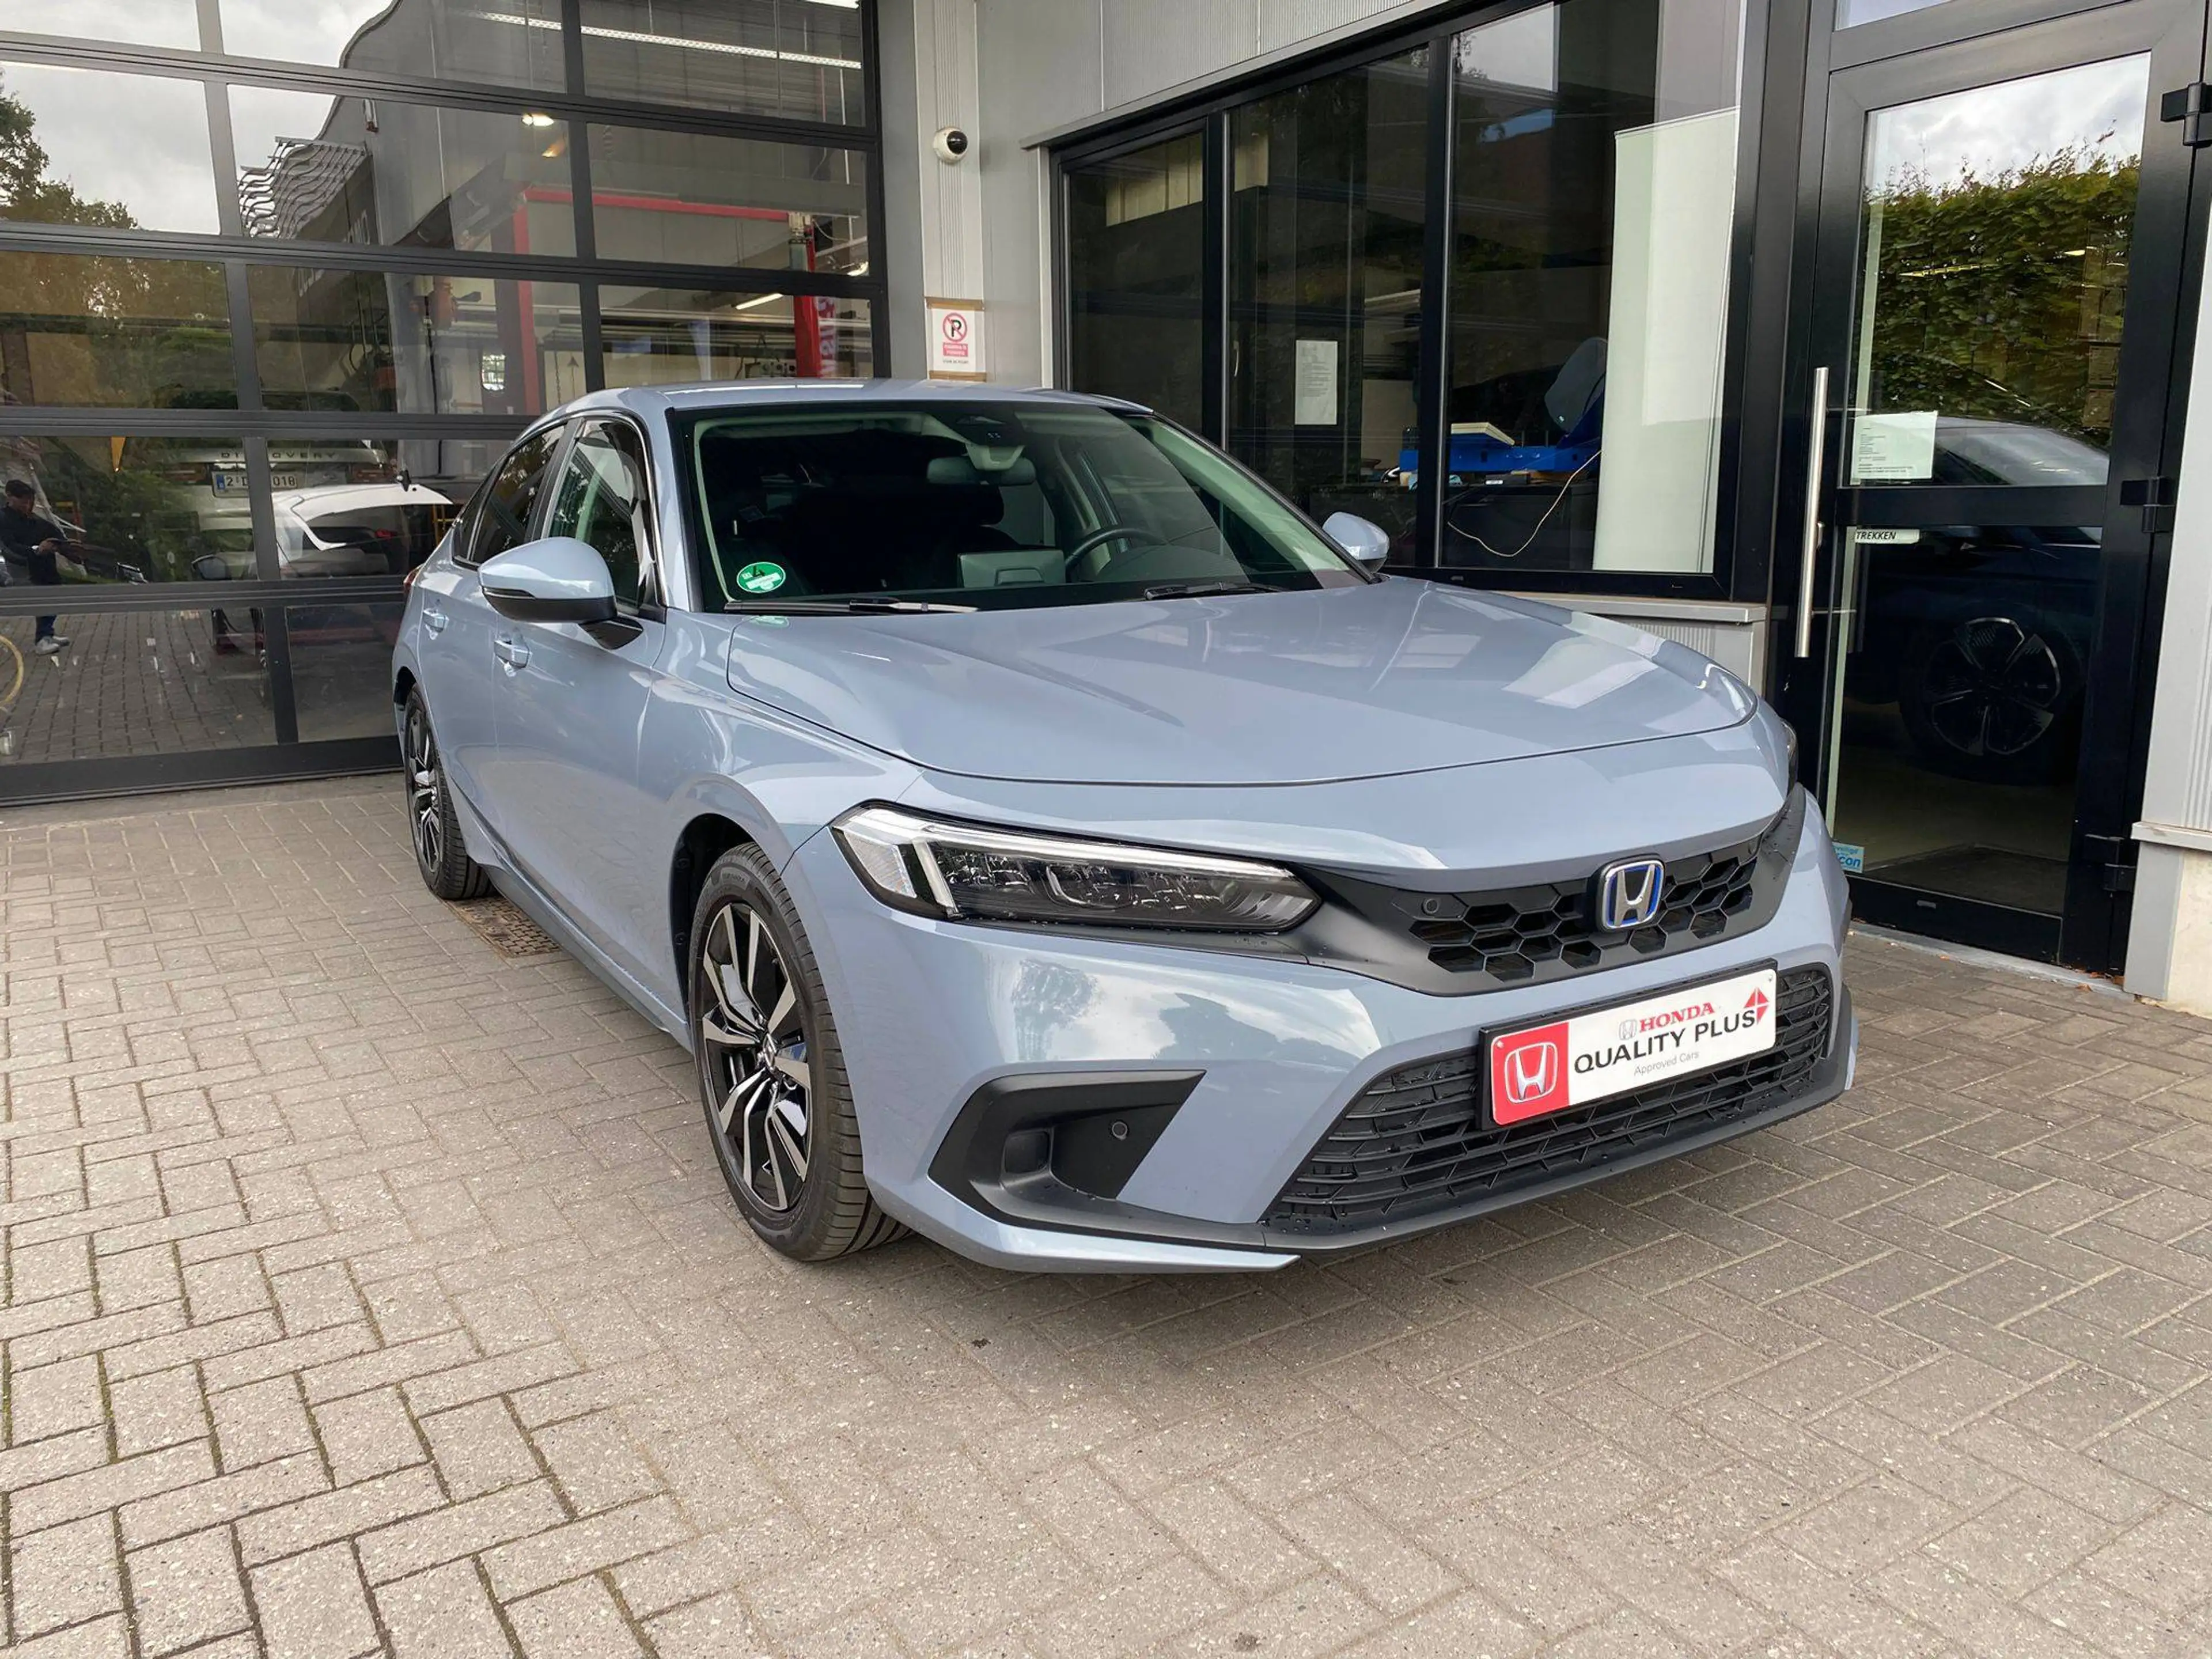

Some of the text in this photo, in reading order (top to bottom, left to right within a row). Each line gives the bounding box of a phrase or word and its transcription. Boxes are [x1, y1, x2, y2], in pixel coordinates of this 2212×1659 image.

[1856, 531, 1896, 540] TREKKEN
[1639, 1002, 1715, 1033] HONDA
[1574, 1010, 1755, 1074] QUALITY PLUS
[1634, 1051, 1699, 1076] Approved Cars
